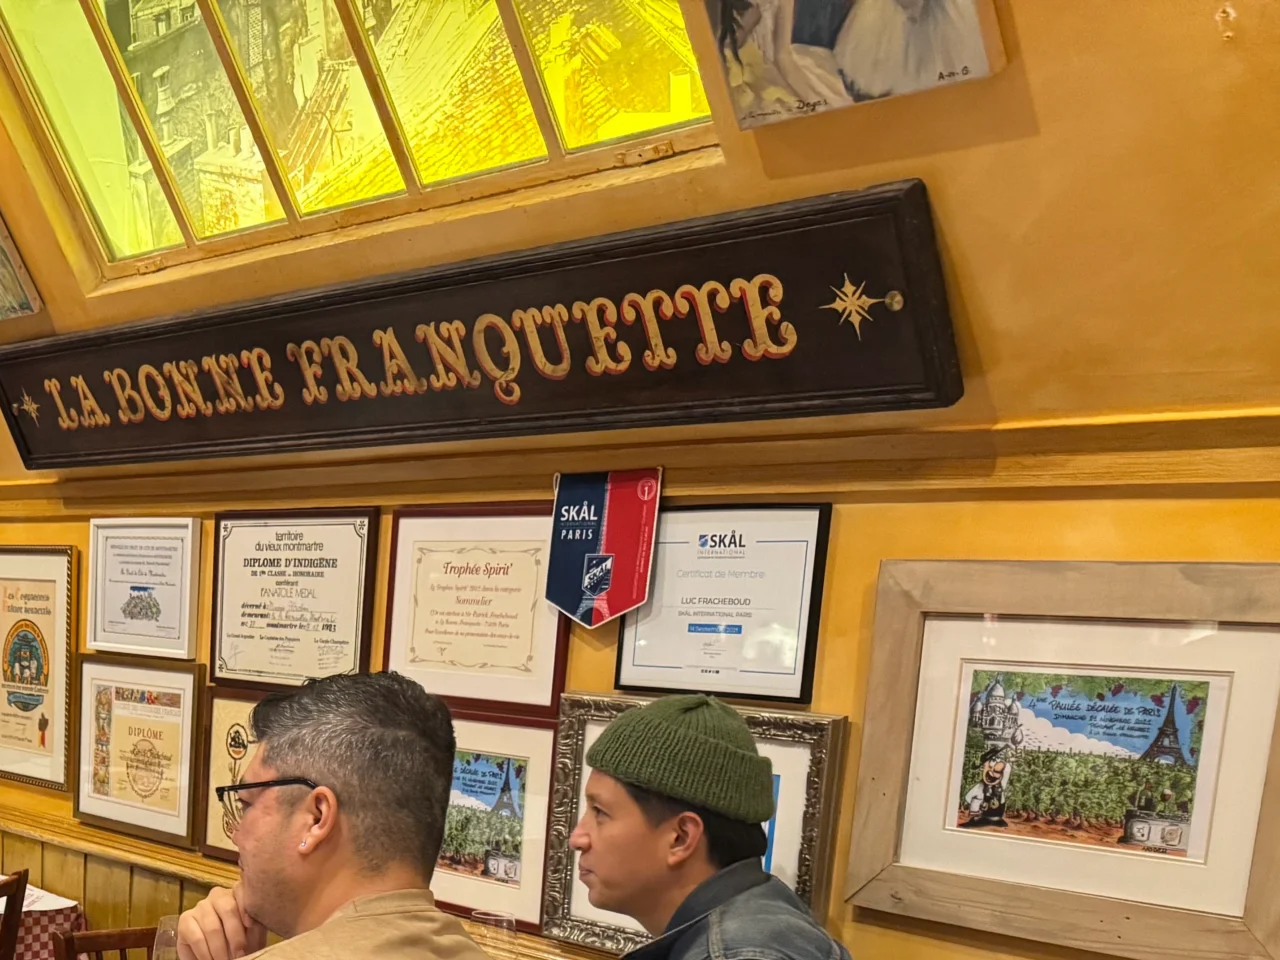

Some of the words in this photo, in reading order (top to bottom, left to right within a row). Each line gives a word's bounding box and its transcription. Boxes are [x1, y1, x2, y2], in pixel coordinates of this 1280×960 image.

[44, 374, 111, 430] LA
[112, 347, 285, 422] BONNE
[286, 272, 798, 405] FRANQUETTE
[560, 500, 598, 521] SKÅL
[275, 530, 304, 541] territoire
[561, 529, 593, 540] PARIS
[709, 529, 746, 548] SKÅL
[254, 541, 264, 551] du
[265, 541, 282, 551] vieux
[283, 541, 324, 551] montmartre
[443, 561, 481, 578] Trophée
[676, 569, 712, 578] Certificat
[714, 570, 725, 578] de
[728, 570, 765, 579] Membre
[681, 597, 697, 605] LUC
[698, 597, 751, 606] FRACHEBOUD
[1048, 700, 1082, 712] PAULÉE
[1124, 707, 1135, 716] DE
[1136, 706, 1161, 718] PARIS
[128, 726, 164, 740] DIPLÔME
